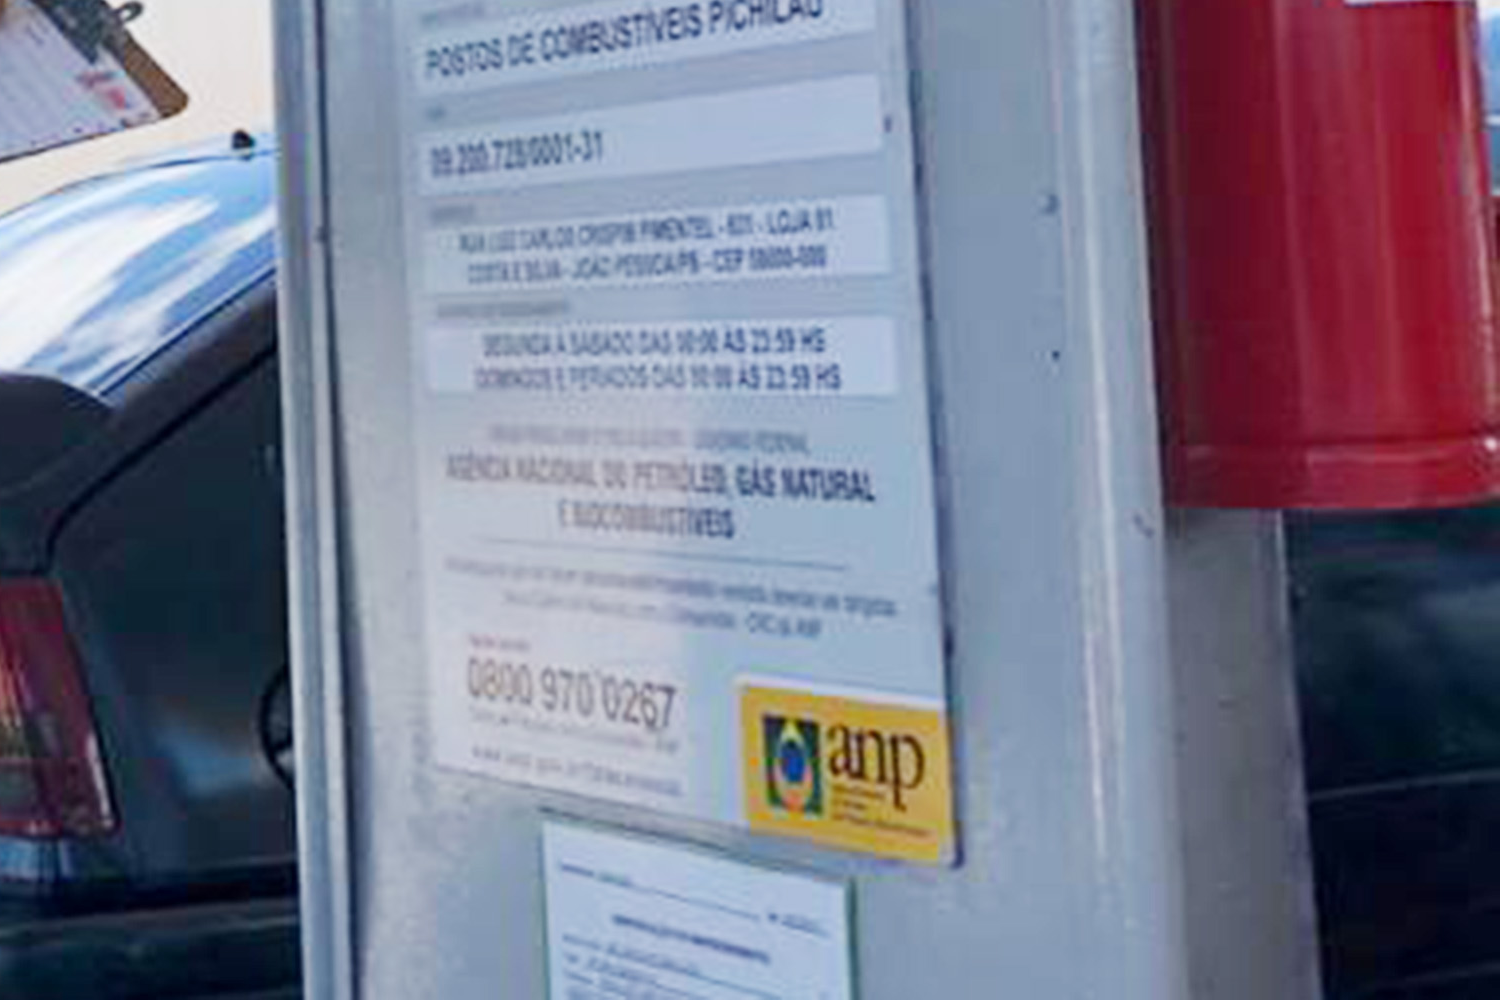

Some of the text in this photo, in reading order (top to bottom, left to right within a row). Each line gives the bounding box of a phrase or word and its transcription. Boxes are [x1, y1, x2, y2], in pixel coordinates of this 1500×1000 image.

[426, 38, 503, 78] POSTOS
[507, 31, 535, 67] DE
[767, 208, 810, 235] LOJA
[714, 248, 745, 273] CEP
[801, 327, 826, 353] HS
[815, 362, 842, 390] HS
[516, 454, 599, 488] NACIONAL
[734, 455, 777, 498] GÁS
[780, 465, 877, 502] NATURAL
[467, 655, 534, 706] 0800
[540, 666, 596, 718] 970
[600, 675, 678, 731] 0267
[826, 721, 926, 813] anp
